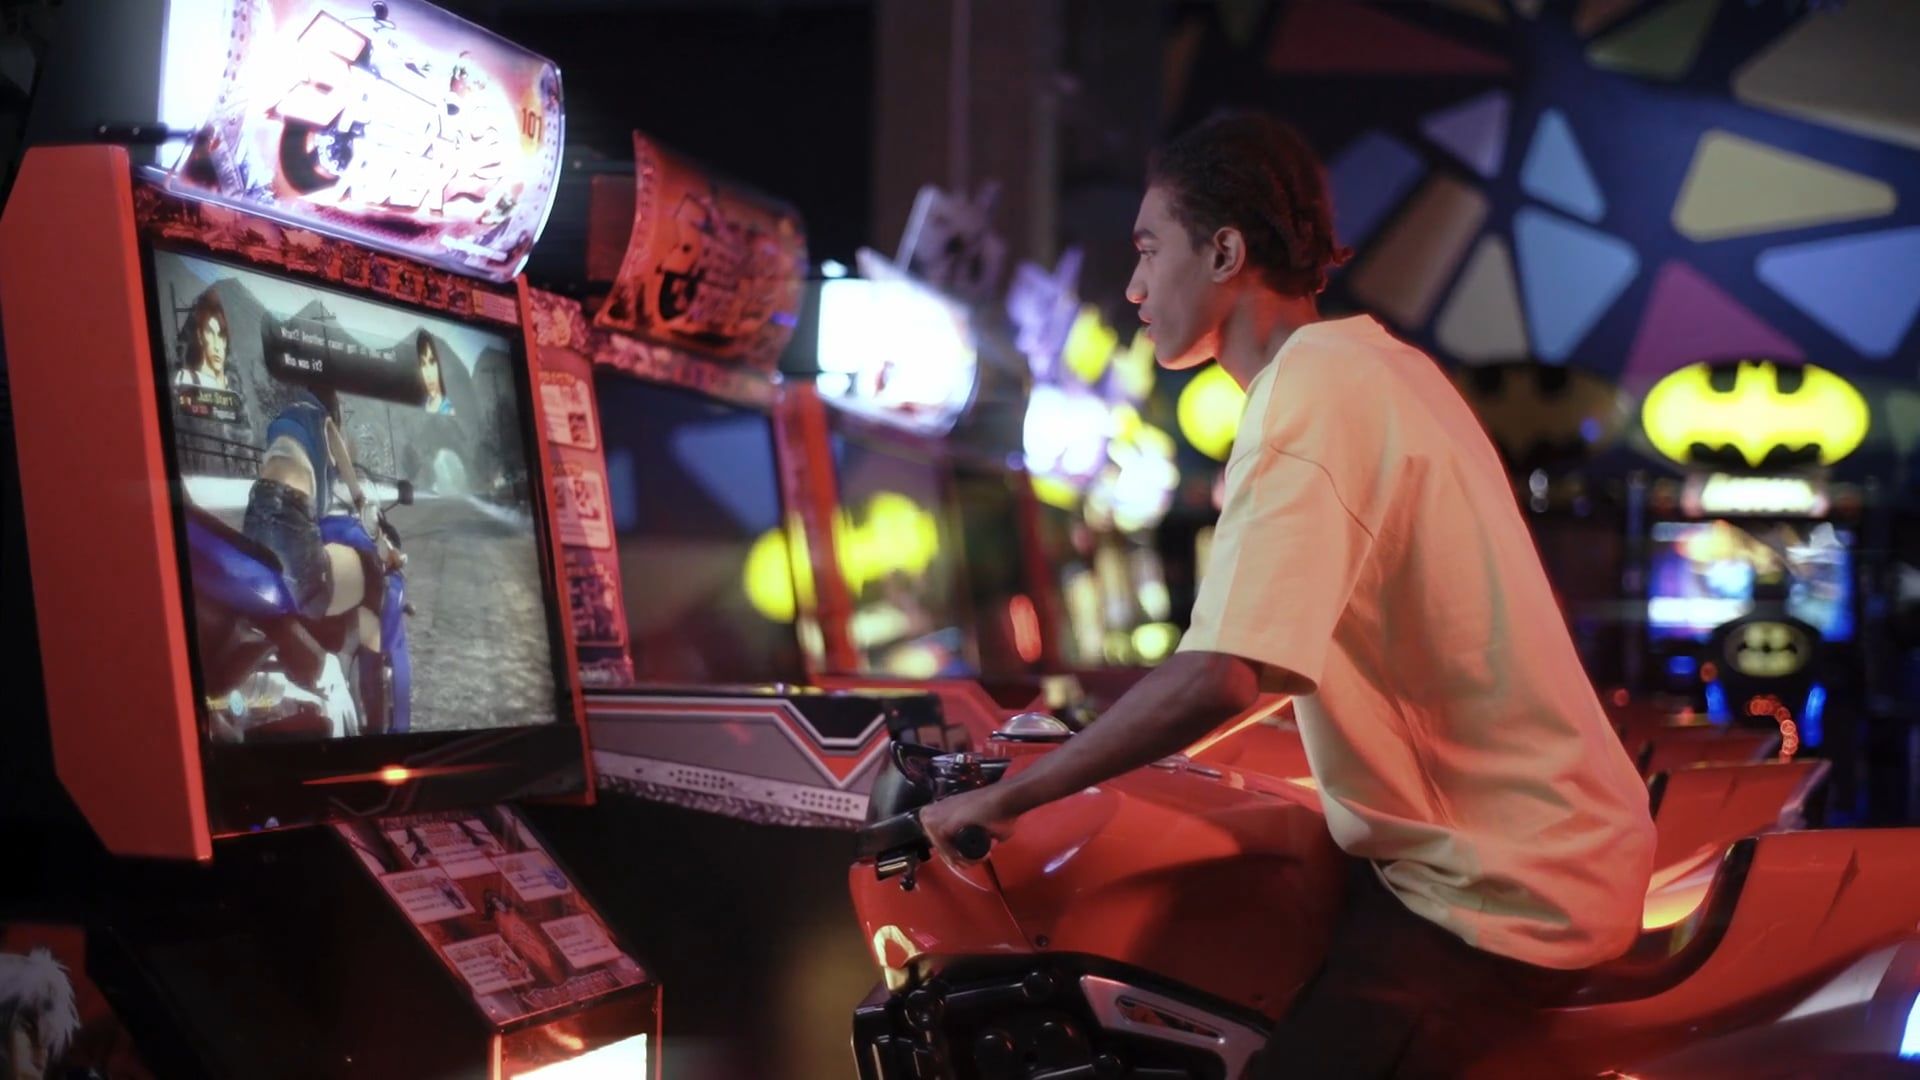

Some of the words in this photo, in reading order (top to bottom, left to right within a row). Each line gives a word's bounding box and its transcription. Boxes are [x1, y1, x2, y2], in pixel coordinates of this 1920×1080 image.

[521, 108, 543, 141] 101
[283, 352, 297, 367] Who
[298, 359, 310, 370] was
[311, 358, 324, 373] it?
